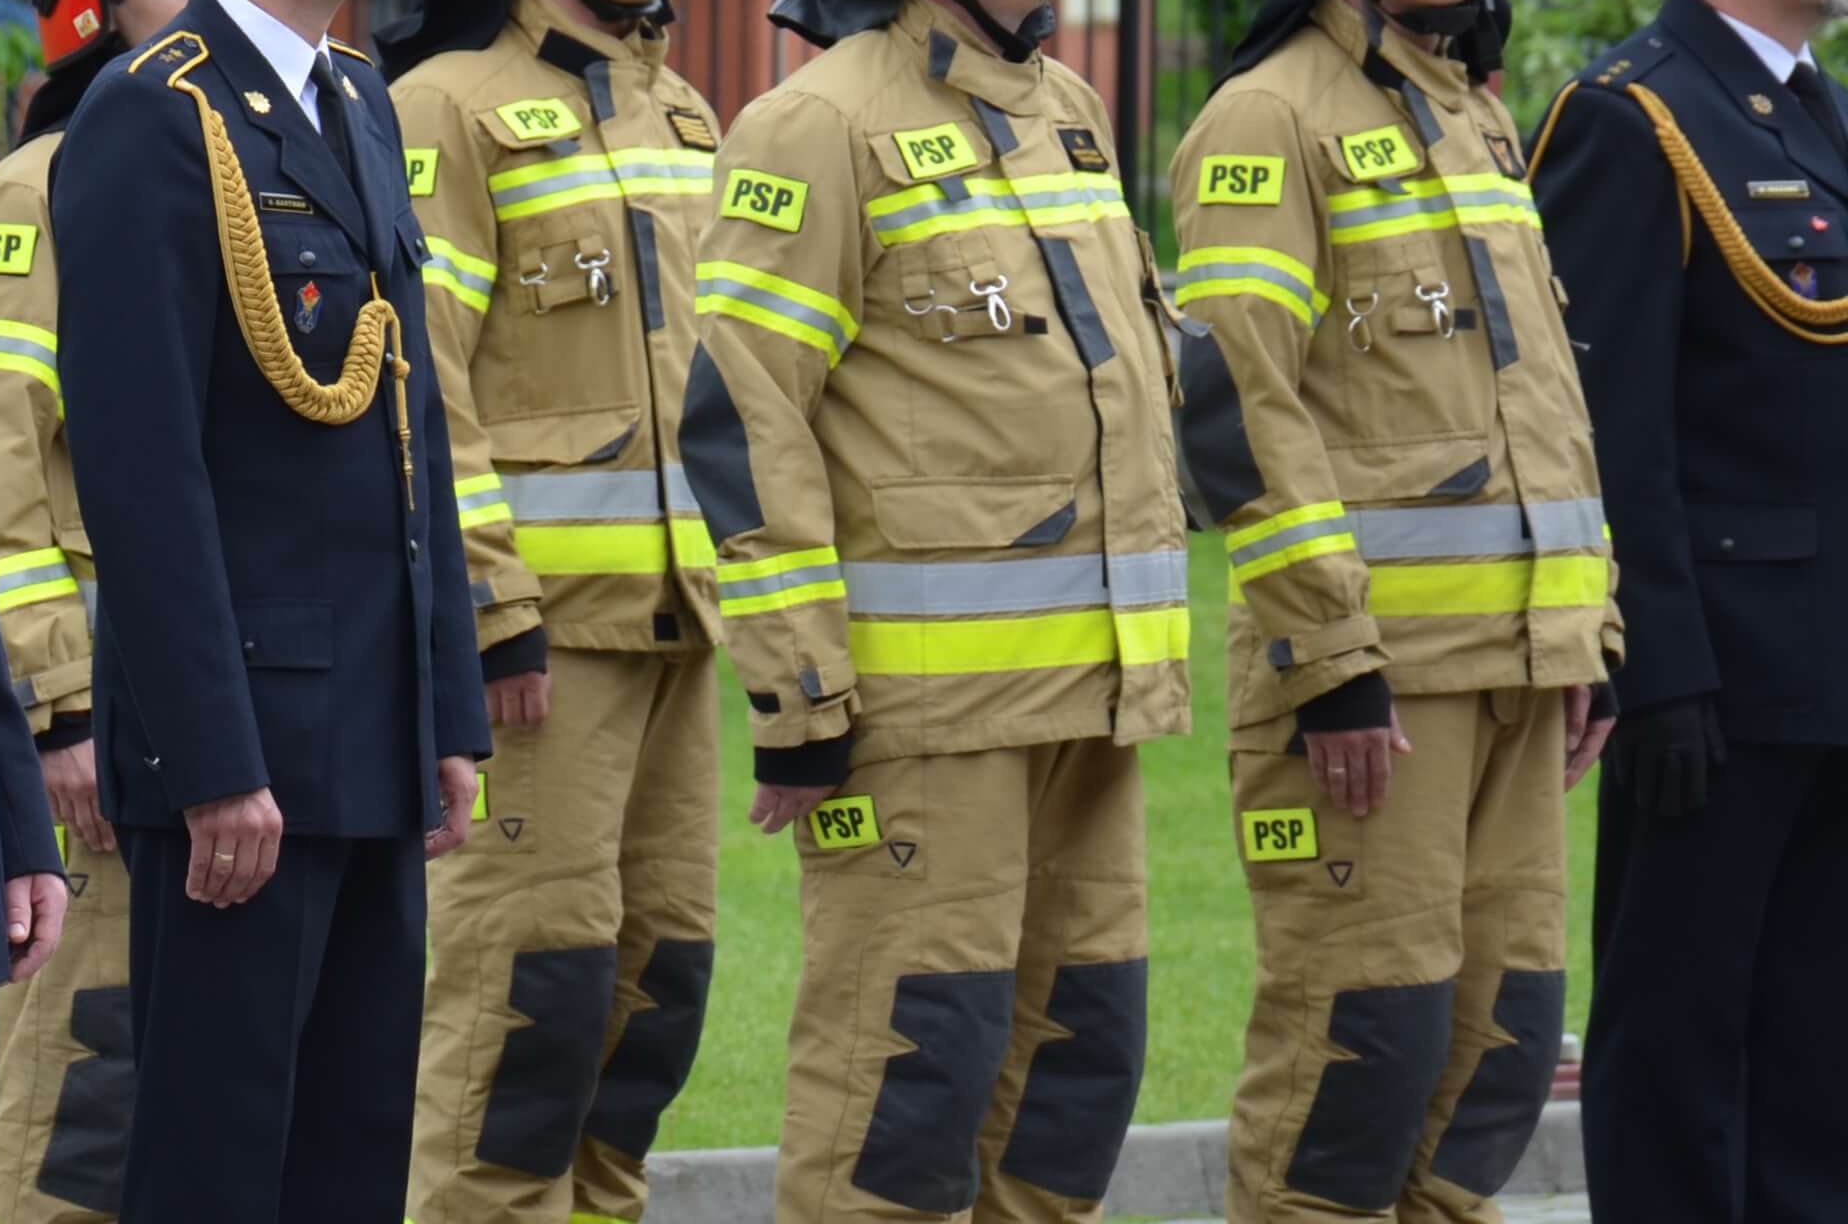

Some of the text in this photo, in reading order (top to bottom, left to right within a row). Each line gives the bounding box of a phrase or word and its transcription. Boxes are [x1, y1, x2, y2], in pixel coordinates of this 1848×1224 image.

[514, 107, 558, 130] PSP
[908, 134, 955, 167] PSP
[1350, 138, 1396, 169] PSP
[1209, 164, 1270, 194] PSP
[731, 178, 794, 217] PSP
[816, 807, 864, 840] PSP
[1253, 819, 1304, 851] PSP
